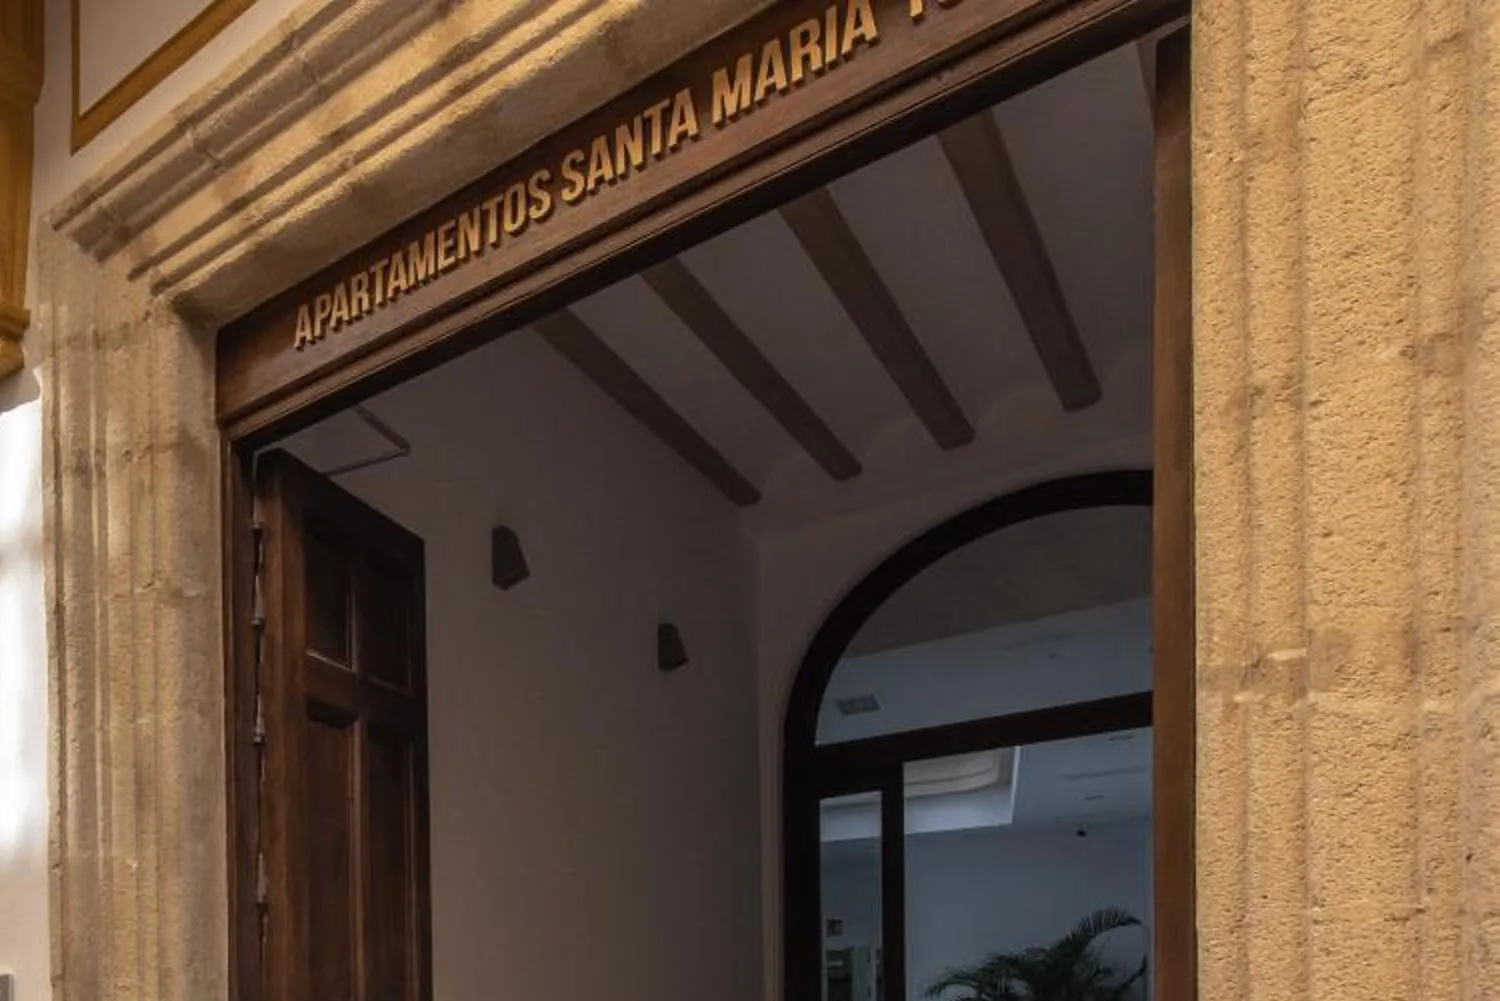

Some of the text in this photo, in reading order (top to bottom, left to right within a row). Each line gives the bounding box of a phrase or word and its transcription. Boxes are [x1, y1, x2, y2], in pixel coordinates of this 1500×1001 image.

[294, 0, 878, 350] APARTAMENTOS SANTA MARIA
